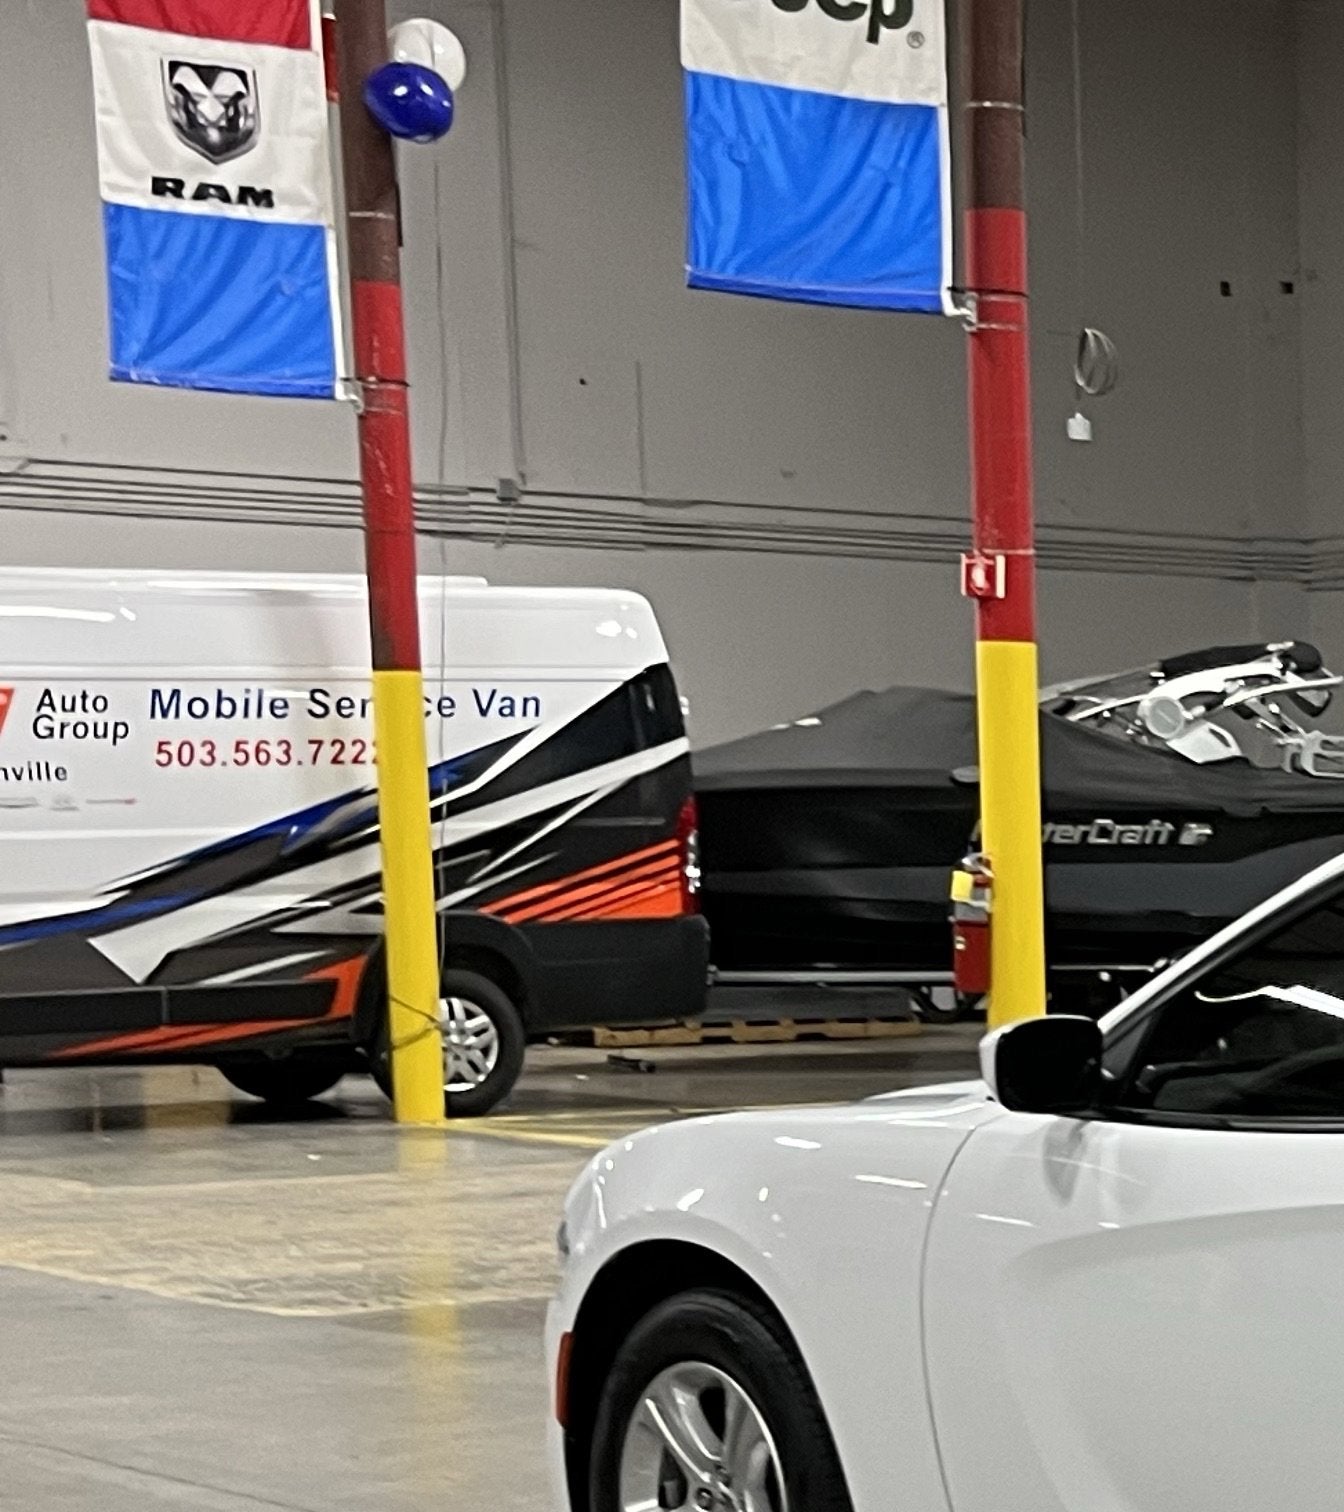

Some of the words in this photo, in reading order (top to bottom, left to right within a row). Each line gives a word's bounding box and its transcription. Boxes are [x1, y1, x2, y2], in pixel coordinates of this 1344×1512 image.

[150, 176, 275, 209] RAM
[36, 688, 109, 713] Auto
[149, 688, 290, 720] Mobile
[472, 688, 541, 718] Van
[32, 714, 130, 747] Group
